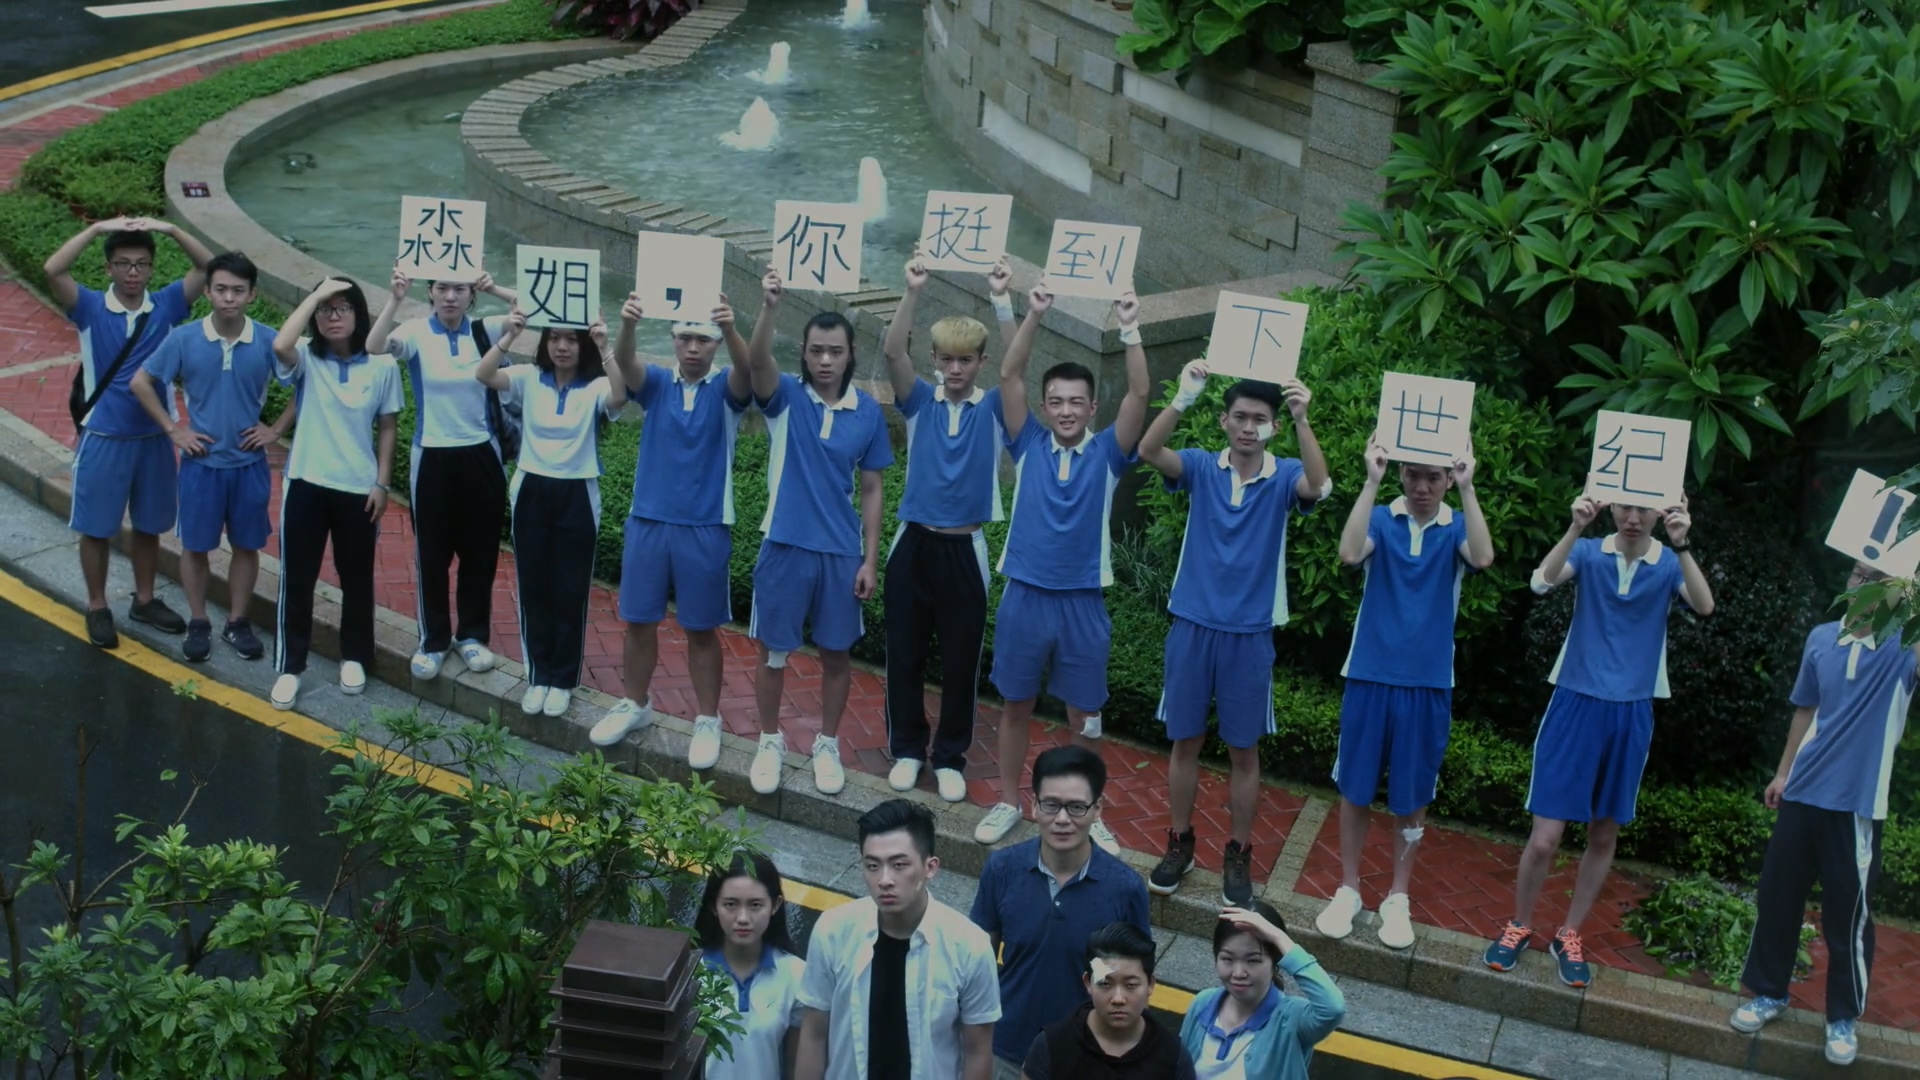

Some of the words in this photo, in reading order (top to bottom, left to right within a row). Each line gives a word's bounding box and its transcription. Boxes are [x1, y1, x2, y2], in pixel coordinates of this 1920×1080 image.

[399, 202, 475, 271] 淼
[777, 214, 851, 285] 你
[927, 203, 995, 264] 挺
[1050, 230, 1126, 285] 到
[525, 257, 589, 326] 姐
[1231, 304, 1291, 370] 下
[1392, 390, 1459, 458] 世
[1596, 425, 1666, 498] 纪
